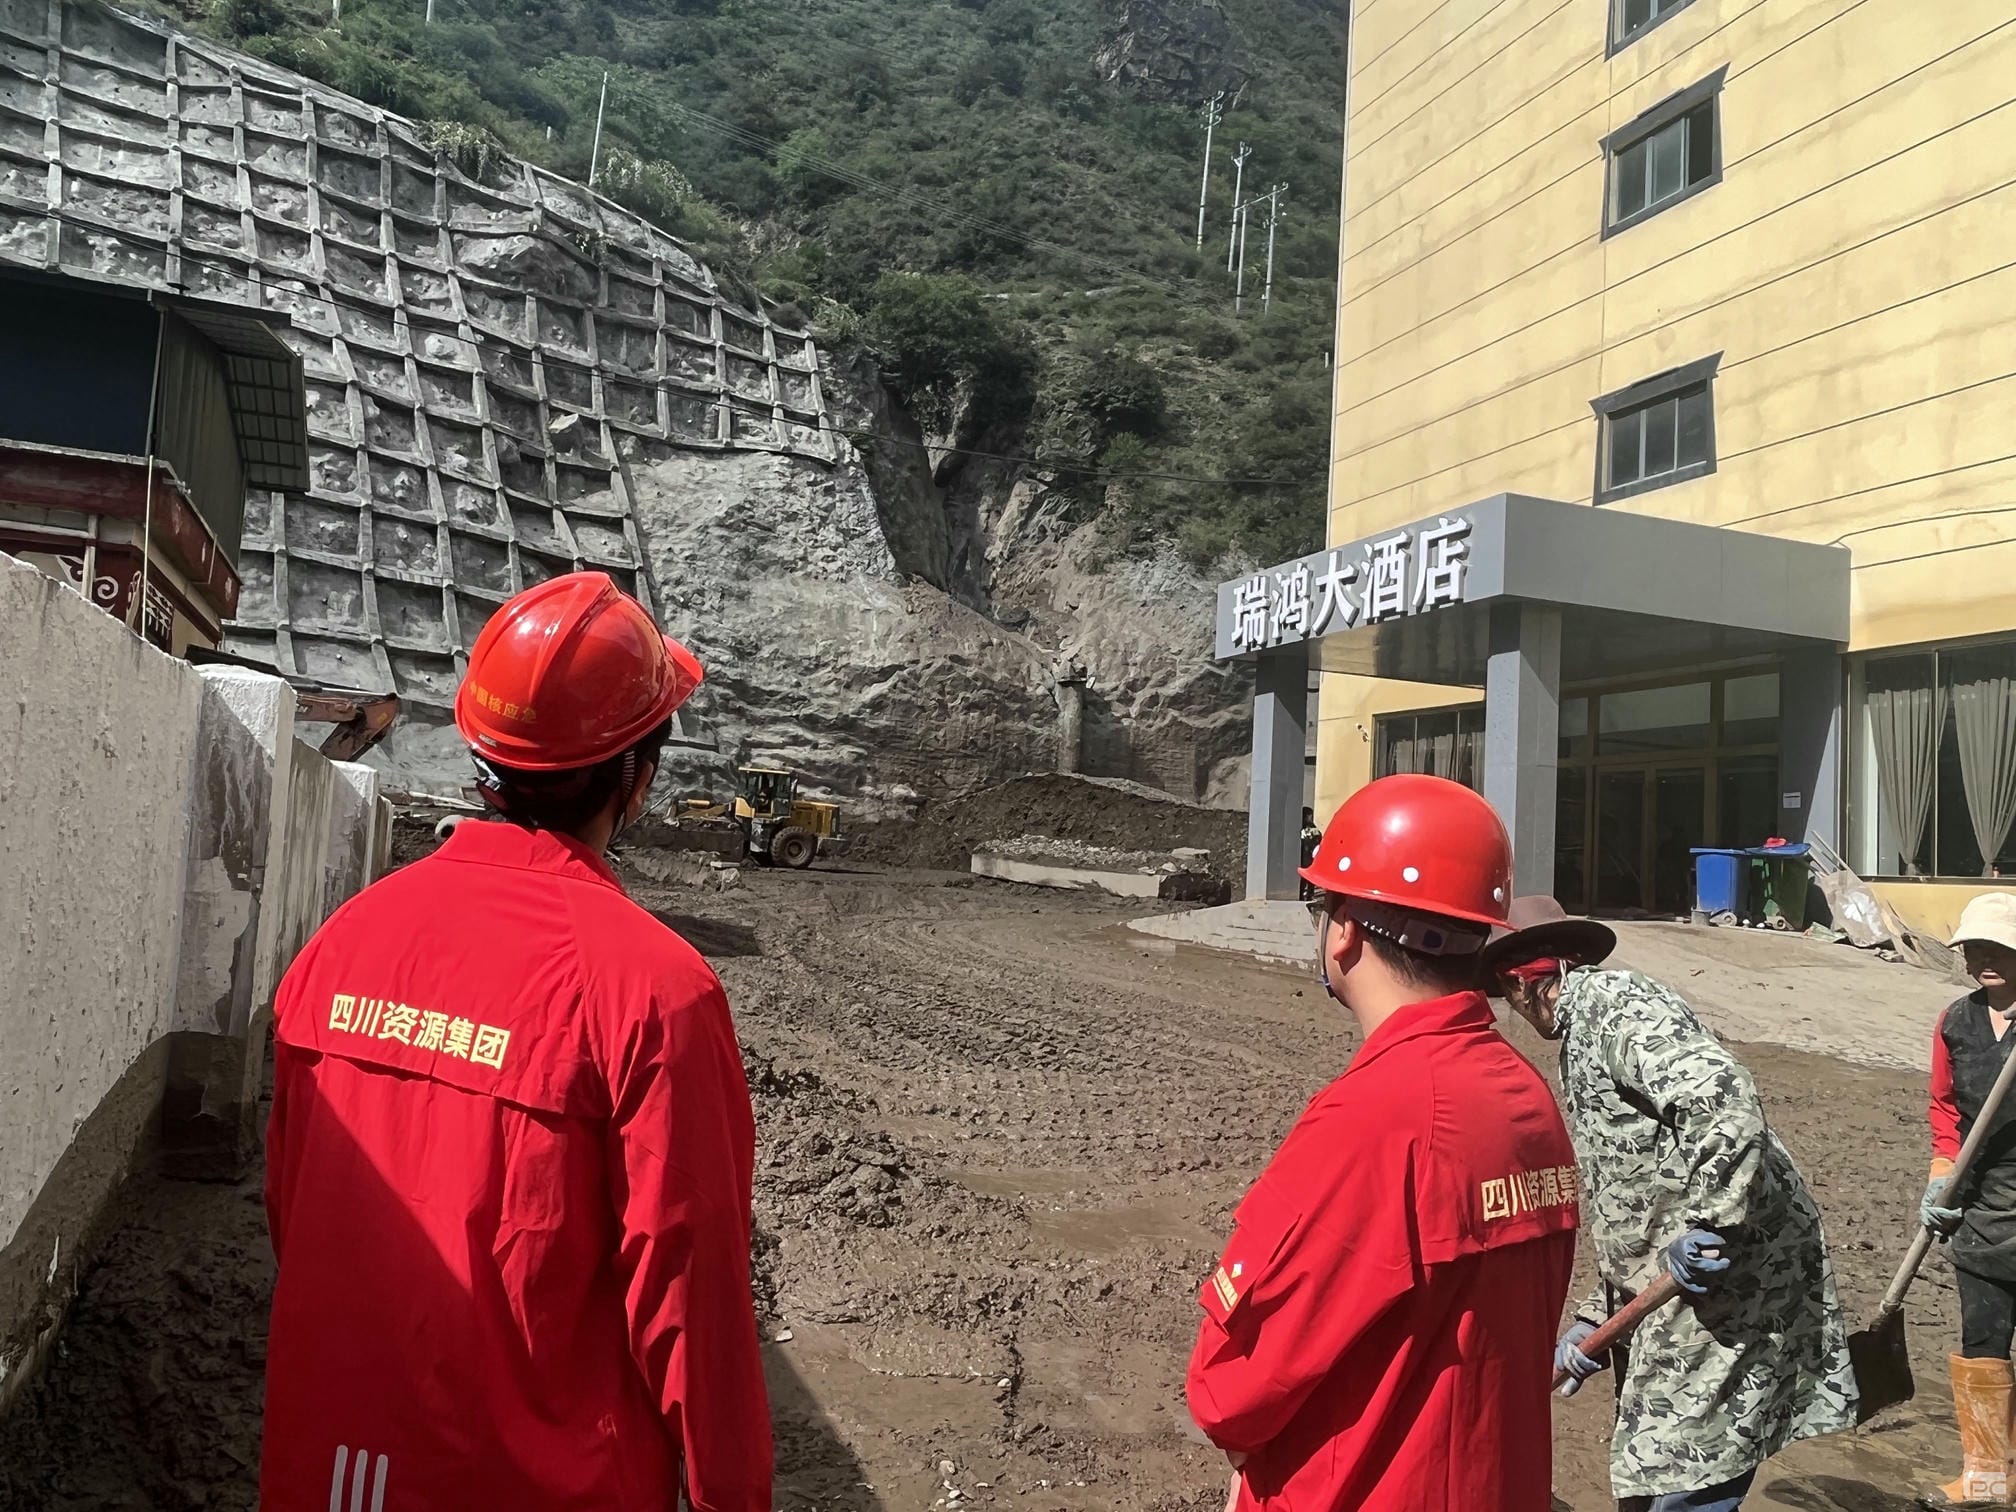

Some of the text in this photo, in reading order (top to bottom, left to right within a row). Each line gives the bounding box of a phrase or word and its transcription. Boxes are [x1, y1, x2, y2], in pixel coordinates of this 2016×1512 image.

[1231, 517, 1470, 648] 瑞鸿大酒店
[328, 993, 511, 1070] 四川资源集团
